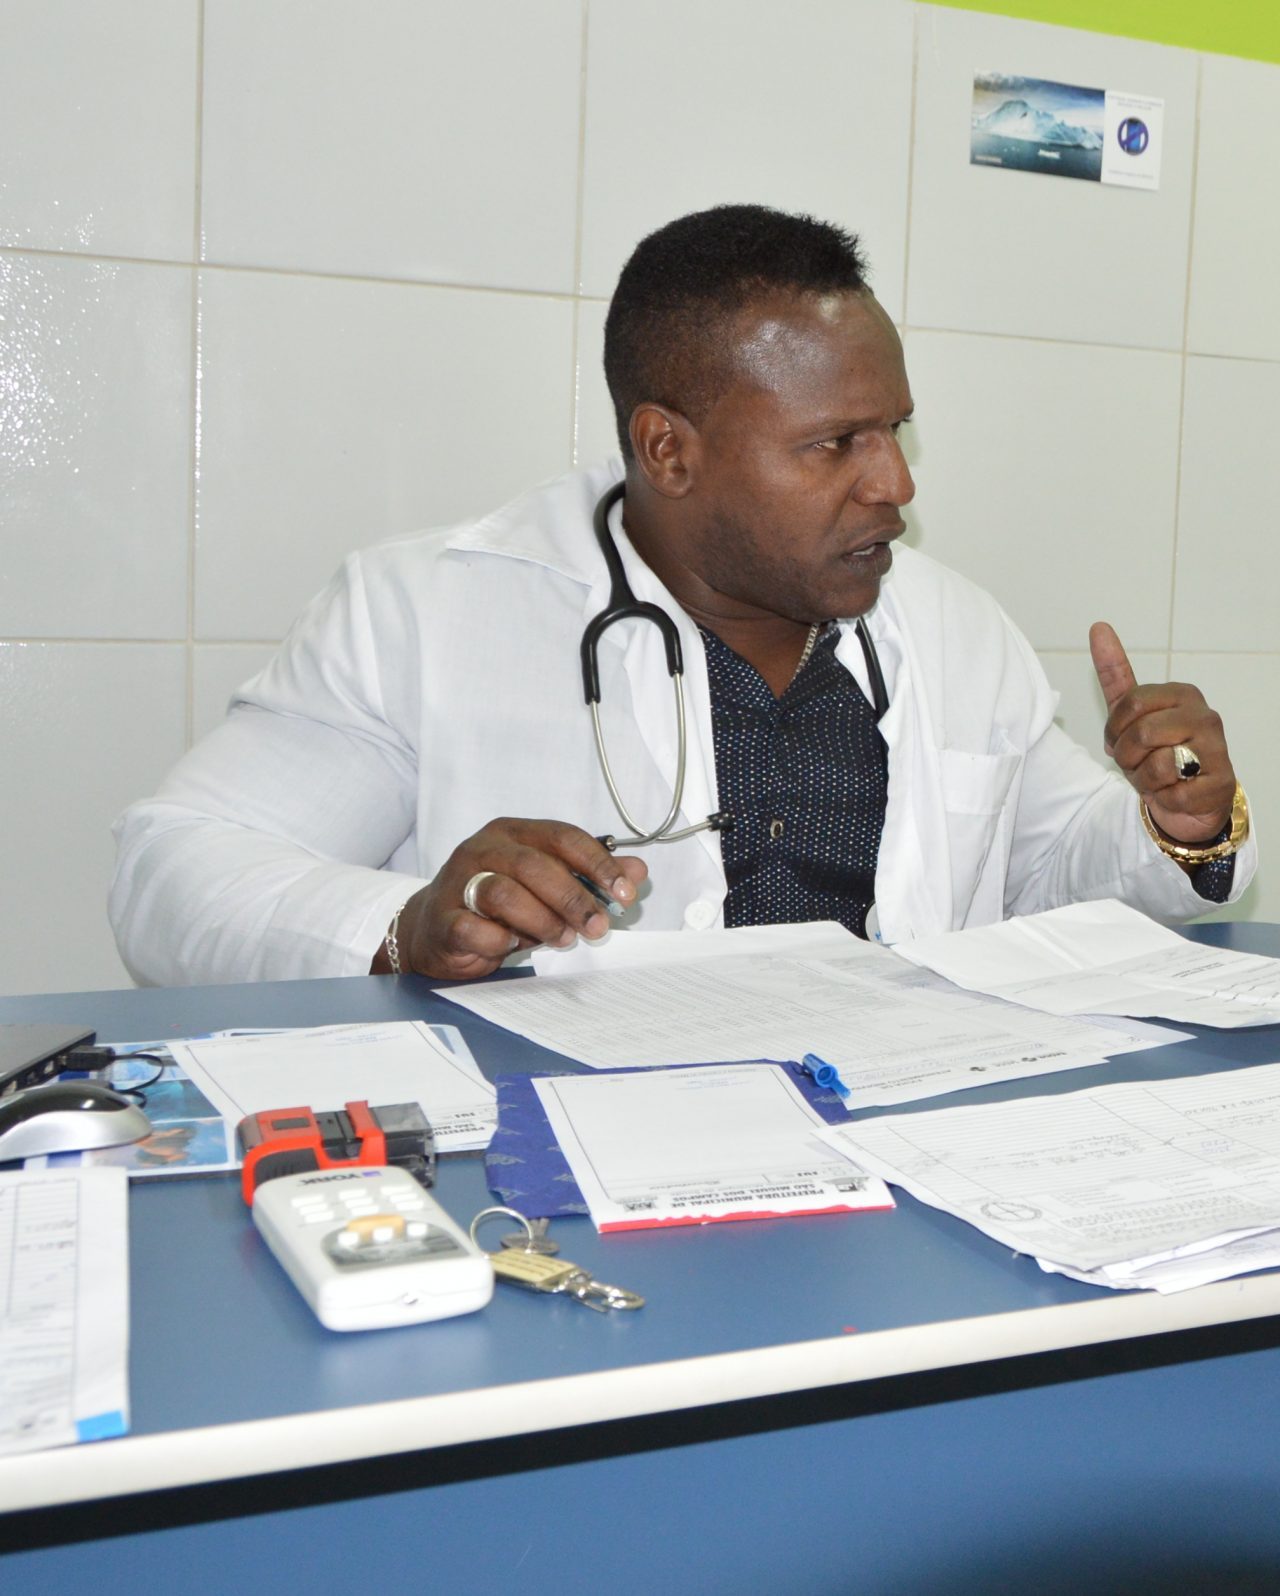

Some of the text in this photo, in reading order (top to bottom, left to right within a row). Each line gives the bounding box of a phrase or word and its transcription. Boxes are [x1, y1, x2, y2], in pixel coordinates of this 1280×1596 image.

[750, 1185, 789, 1193] MIGUEL
[793, 1182, 815, 1190] SÃO
[672, 1192, 718, 1202] CAMPOS
[755, 1188, 824, 1199] PREFEITURA
[690, 1195, 753, 1205] MUNICIPAL
